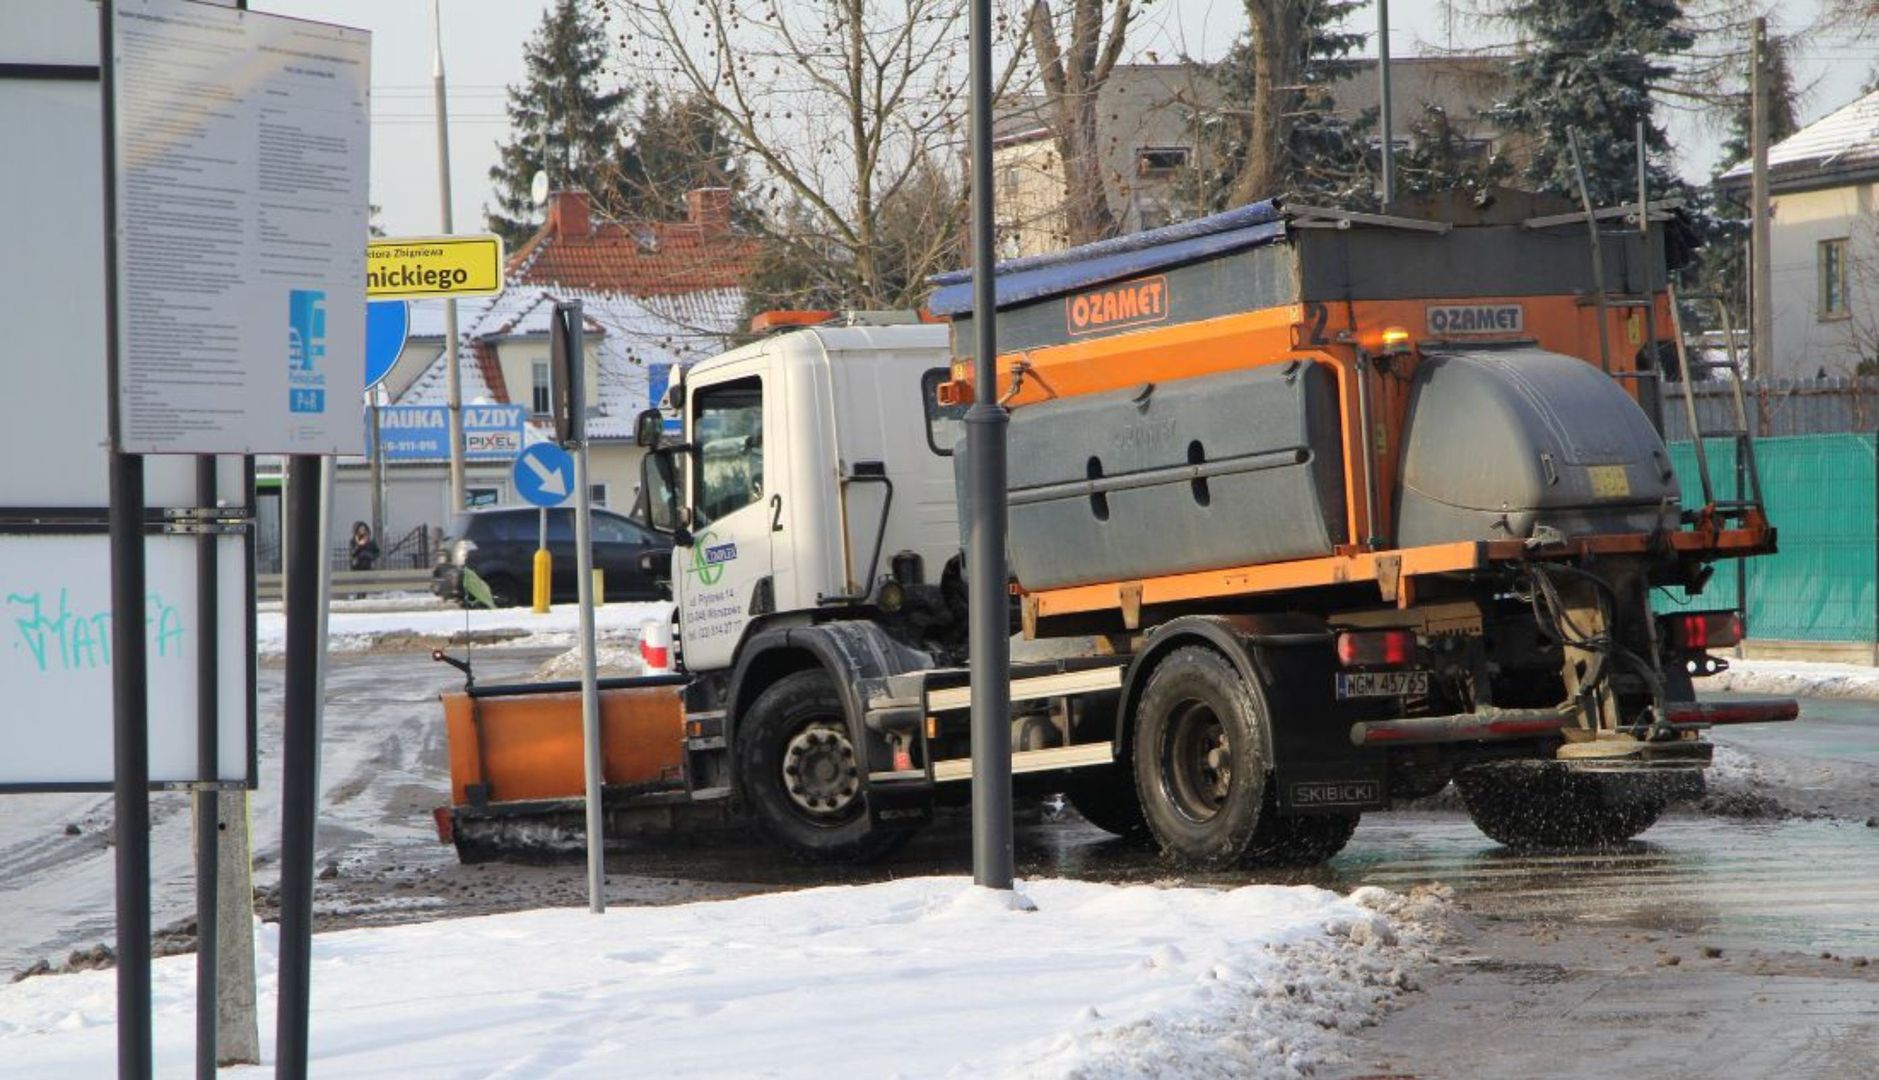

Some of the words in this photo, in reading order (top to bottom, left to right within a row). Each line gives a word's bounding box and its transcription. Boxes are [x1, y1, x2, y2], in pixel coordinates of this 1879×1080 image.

[394, 247, 444, 259] Zbigniewa
[367, 264, 468, 290] nickiego
[1072, 282, 1162, 328] OZAMET
[1306, 301, 1330, 346] 2
[1431, 308, 1520, 331] OZAMET
[463, 408, 521, 428] AZDY
[468, 435, 517, 448] PIXEL
[770, 493, 784, 532] 2
[1297, 784, 1372, 801] SKIBICKI
